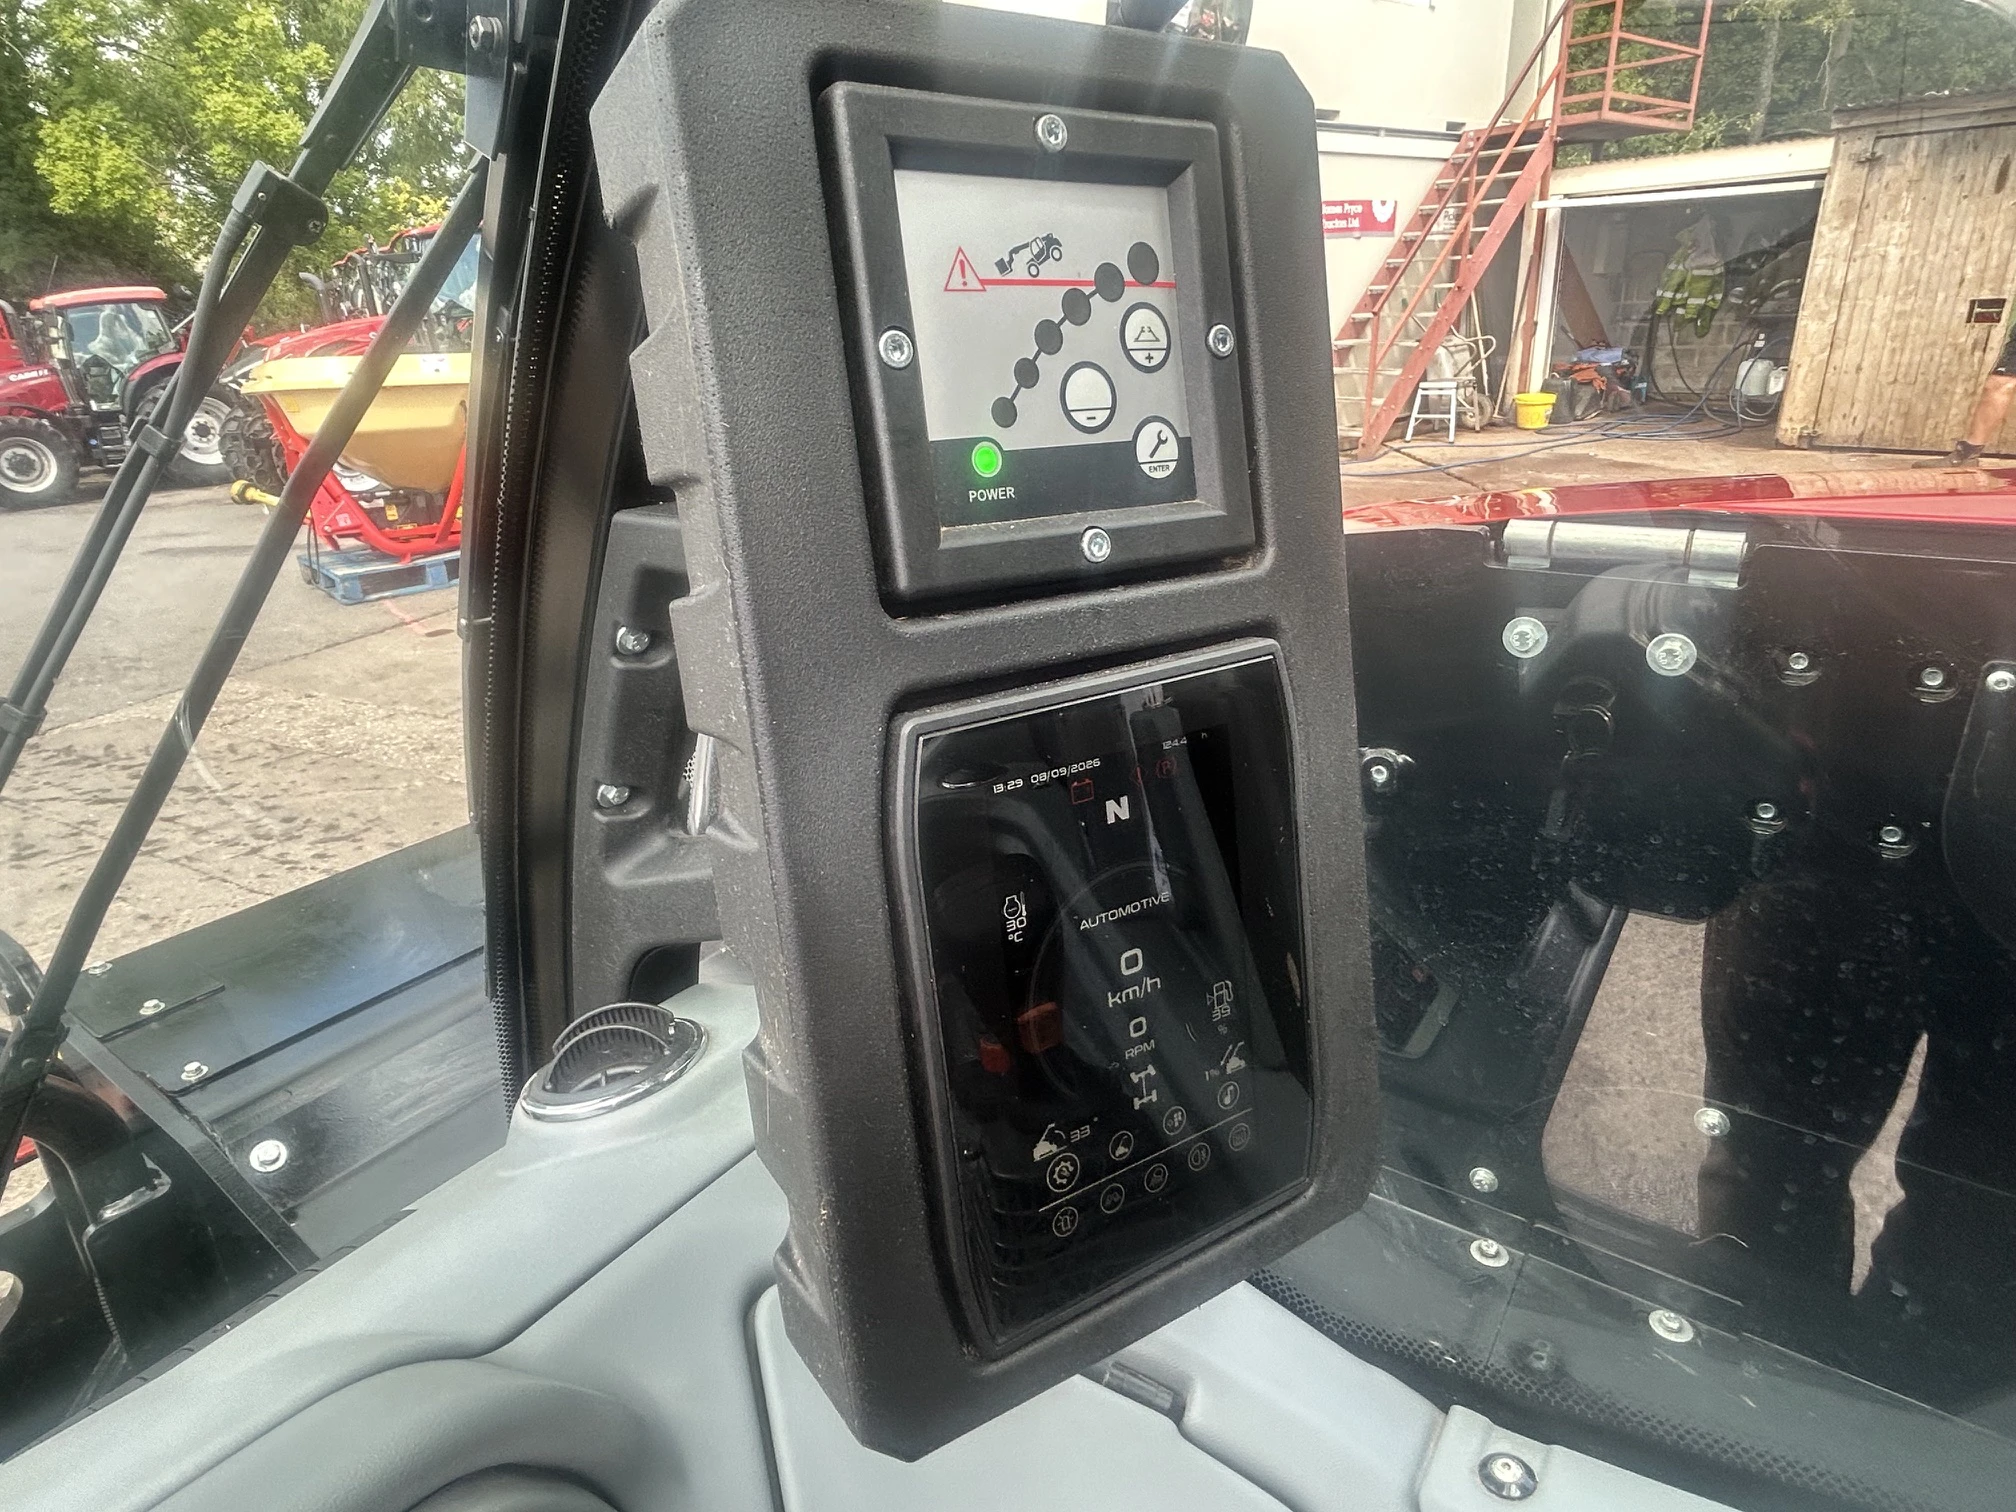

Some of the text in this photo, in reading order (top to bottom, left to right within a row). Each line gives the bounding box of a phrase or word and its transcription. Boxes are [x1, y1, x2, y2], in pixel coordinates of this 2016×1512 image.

[1148, 464, 1170, 473] ENTER
[968, 486, 1015, 502] POWER
[993, 758, 1101, 794] 13:29 08/09/2026
[1105, 795, 1130, 824] N
[1079, 892, 1171, 931] AUTOMOTIVE
[1006, 916, 1027, 931] 30
[1120, 948, 1143, 976] 0
[1107, 976, 1161, 1007] km/h
[1212, 1005, 1231, 1021] 39
[1129, 1016, 1147, 1038] 0
[1125, 1039, 1155, 1059] RPM
